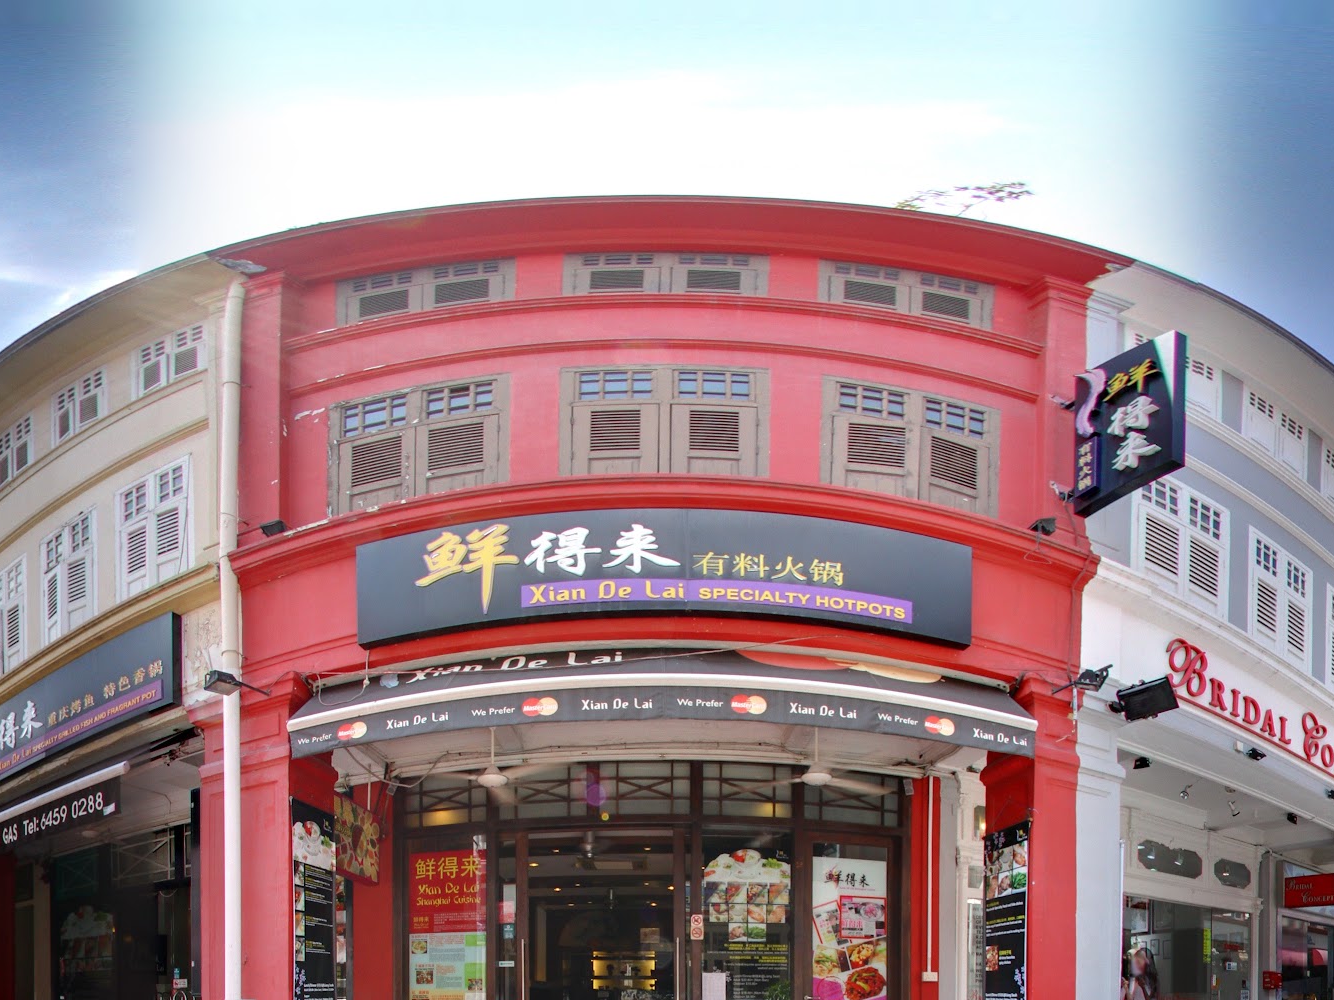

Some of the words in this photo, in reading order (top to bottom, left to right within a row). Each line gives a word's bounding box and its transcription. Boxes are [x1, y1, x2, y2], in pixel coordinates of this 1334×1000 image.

[1103, 358, 1162, 471] 鲜得来
[415, 523, 681, 614] 鲜得来
[692, 551, 844, 586] 有料火锅
[529, 584, 586, 604] Xian
[598, 580, 632, 600] De
[645, 580, 685, 599] Lai
[698, 587, 811, 605] SPECIALTY
[815, 595, 906, 619] HOTPOTS
[406, 663, 483, 685] Xian
[500, 655, 548, 671] De
[567, 651, 623, 667] Lai
[47, 693, 95, 727] 重庆烤鱼
[102, 660, 163, 699] 特色香锅
[1166, 637, 1292, 745] BRIDAL
[471, 707, 487, 717] We
[488, 705, 516, 716] Prefer
[581, 698, 609, 711] Xian
[613, 697, 629, 710] De
[633, 698, 653, 710] Lai
[676, 698, 693, 707] We
[695, 697, 724, 709] Prefer
[789, 702, 815, 715] Xian
[819, 704, 835, 717] De
[839, 707, 857, 719] Lai
[12, 753, 21, 765] De
[21, 746, 33, 760] Lai
[32, 735, 58, 752] SPECIALTY
[57, 724, 80, 742] GRILLED
[80, 716, 94, 730] FISH
[93, 711, 107, 725] AND
[107, 695, 142, 718] FRAGRANT
[141, 689, 157, 703] POT
[386, 718, 409, 730] Xian
[413, 714, 428, 726] De
[431, 711, 449, 723] Lai
[877, 712, 893, 722] We
[893, 714, 919, 726] Prefer
[297, 736, 310, 746] We
[311, 732, 333, 744] Prefer
[972, 727, 994, 742] Xian
[997, 732, 1010, 744] De
[1012, 734, 1028, 747] Lai
[3, 823, 18, 844] GAS
[23, 817, 39, 836] Tel:
[40, 805, 67, 830] 6459
[71, 791, 104, 818] 0288
[415, 855, 482, 880] 鲜得来
[418, 883, 442, 896] Xian
[445, 882, 460, 894] De
[1301, 891, 1334, 903] CONCEPT
[416, 897, 451, 908] Shanghai
[453, 896, 482, 904] Cuisine
